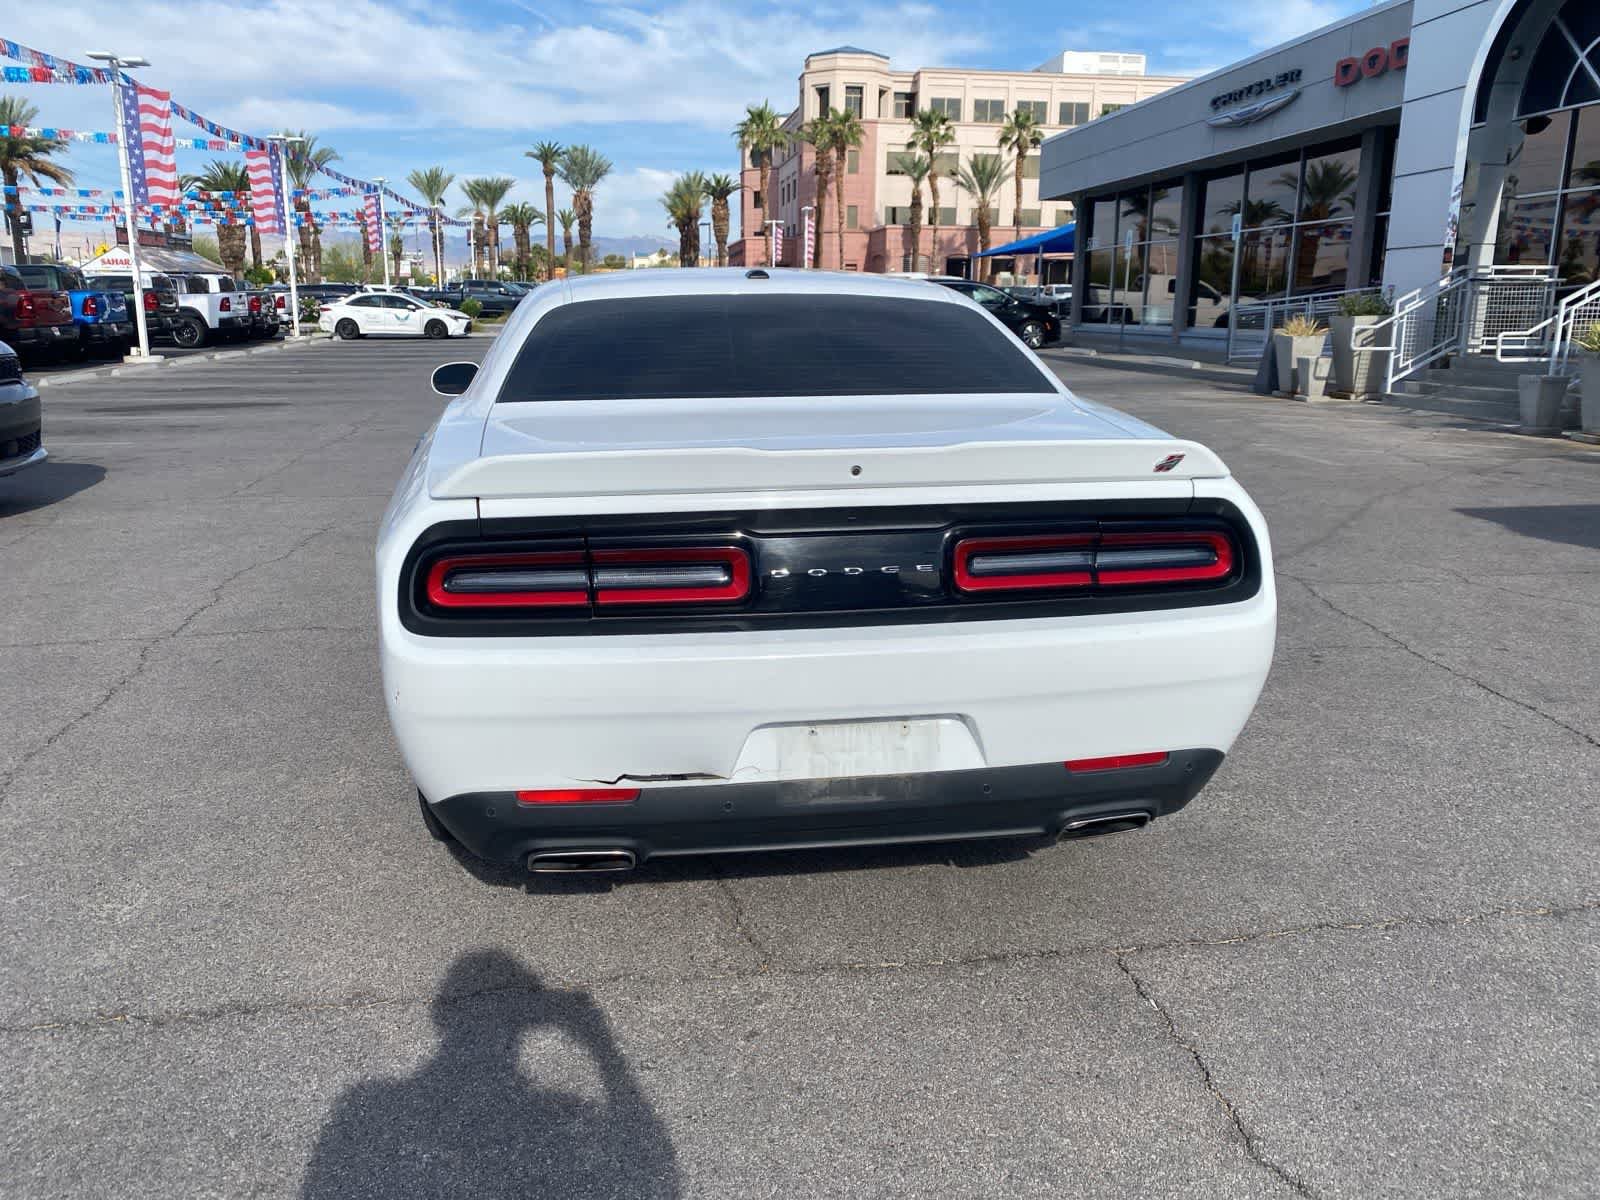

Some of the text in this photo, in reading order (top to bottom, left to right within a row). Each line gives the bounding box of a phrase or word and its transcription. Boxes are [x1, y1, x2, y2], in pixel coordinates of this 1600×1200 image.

[1210, 69, 1302, 109] CHRYSLER
[101, 257, 132, 266] SAHAR
[770, 564, 934, 578] DODGE
